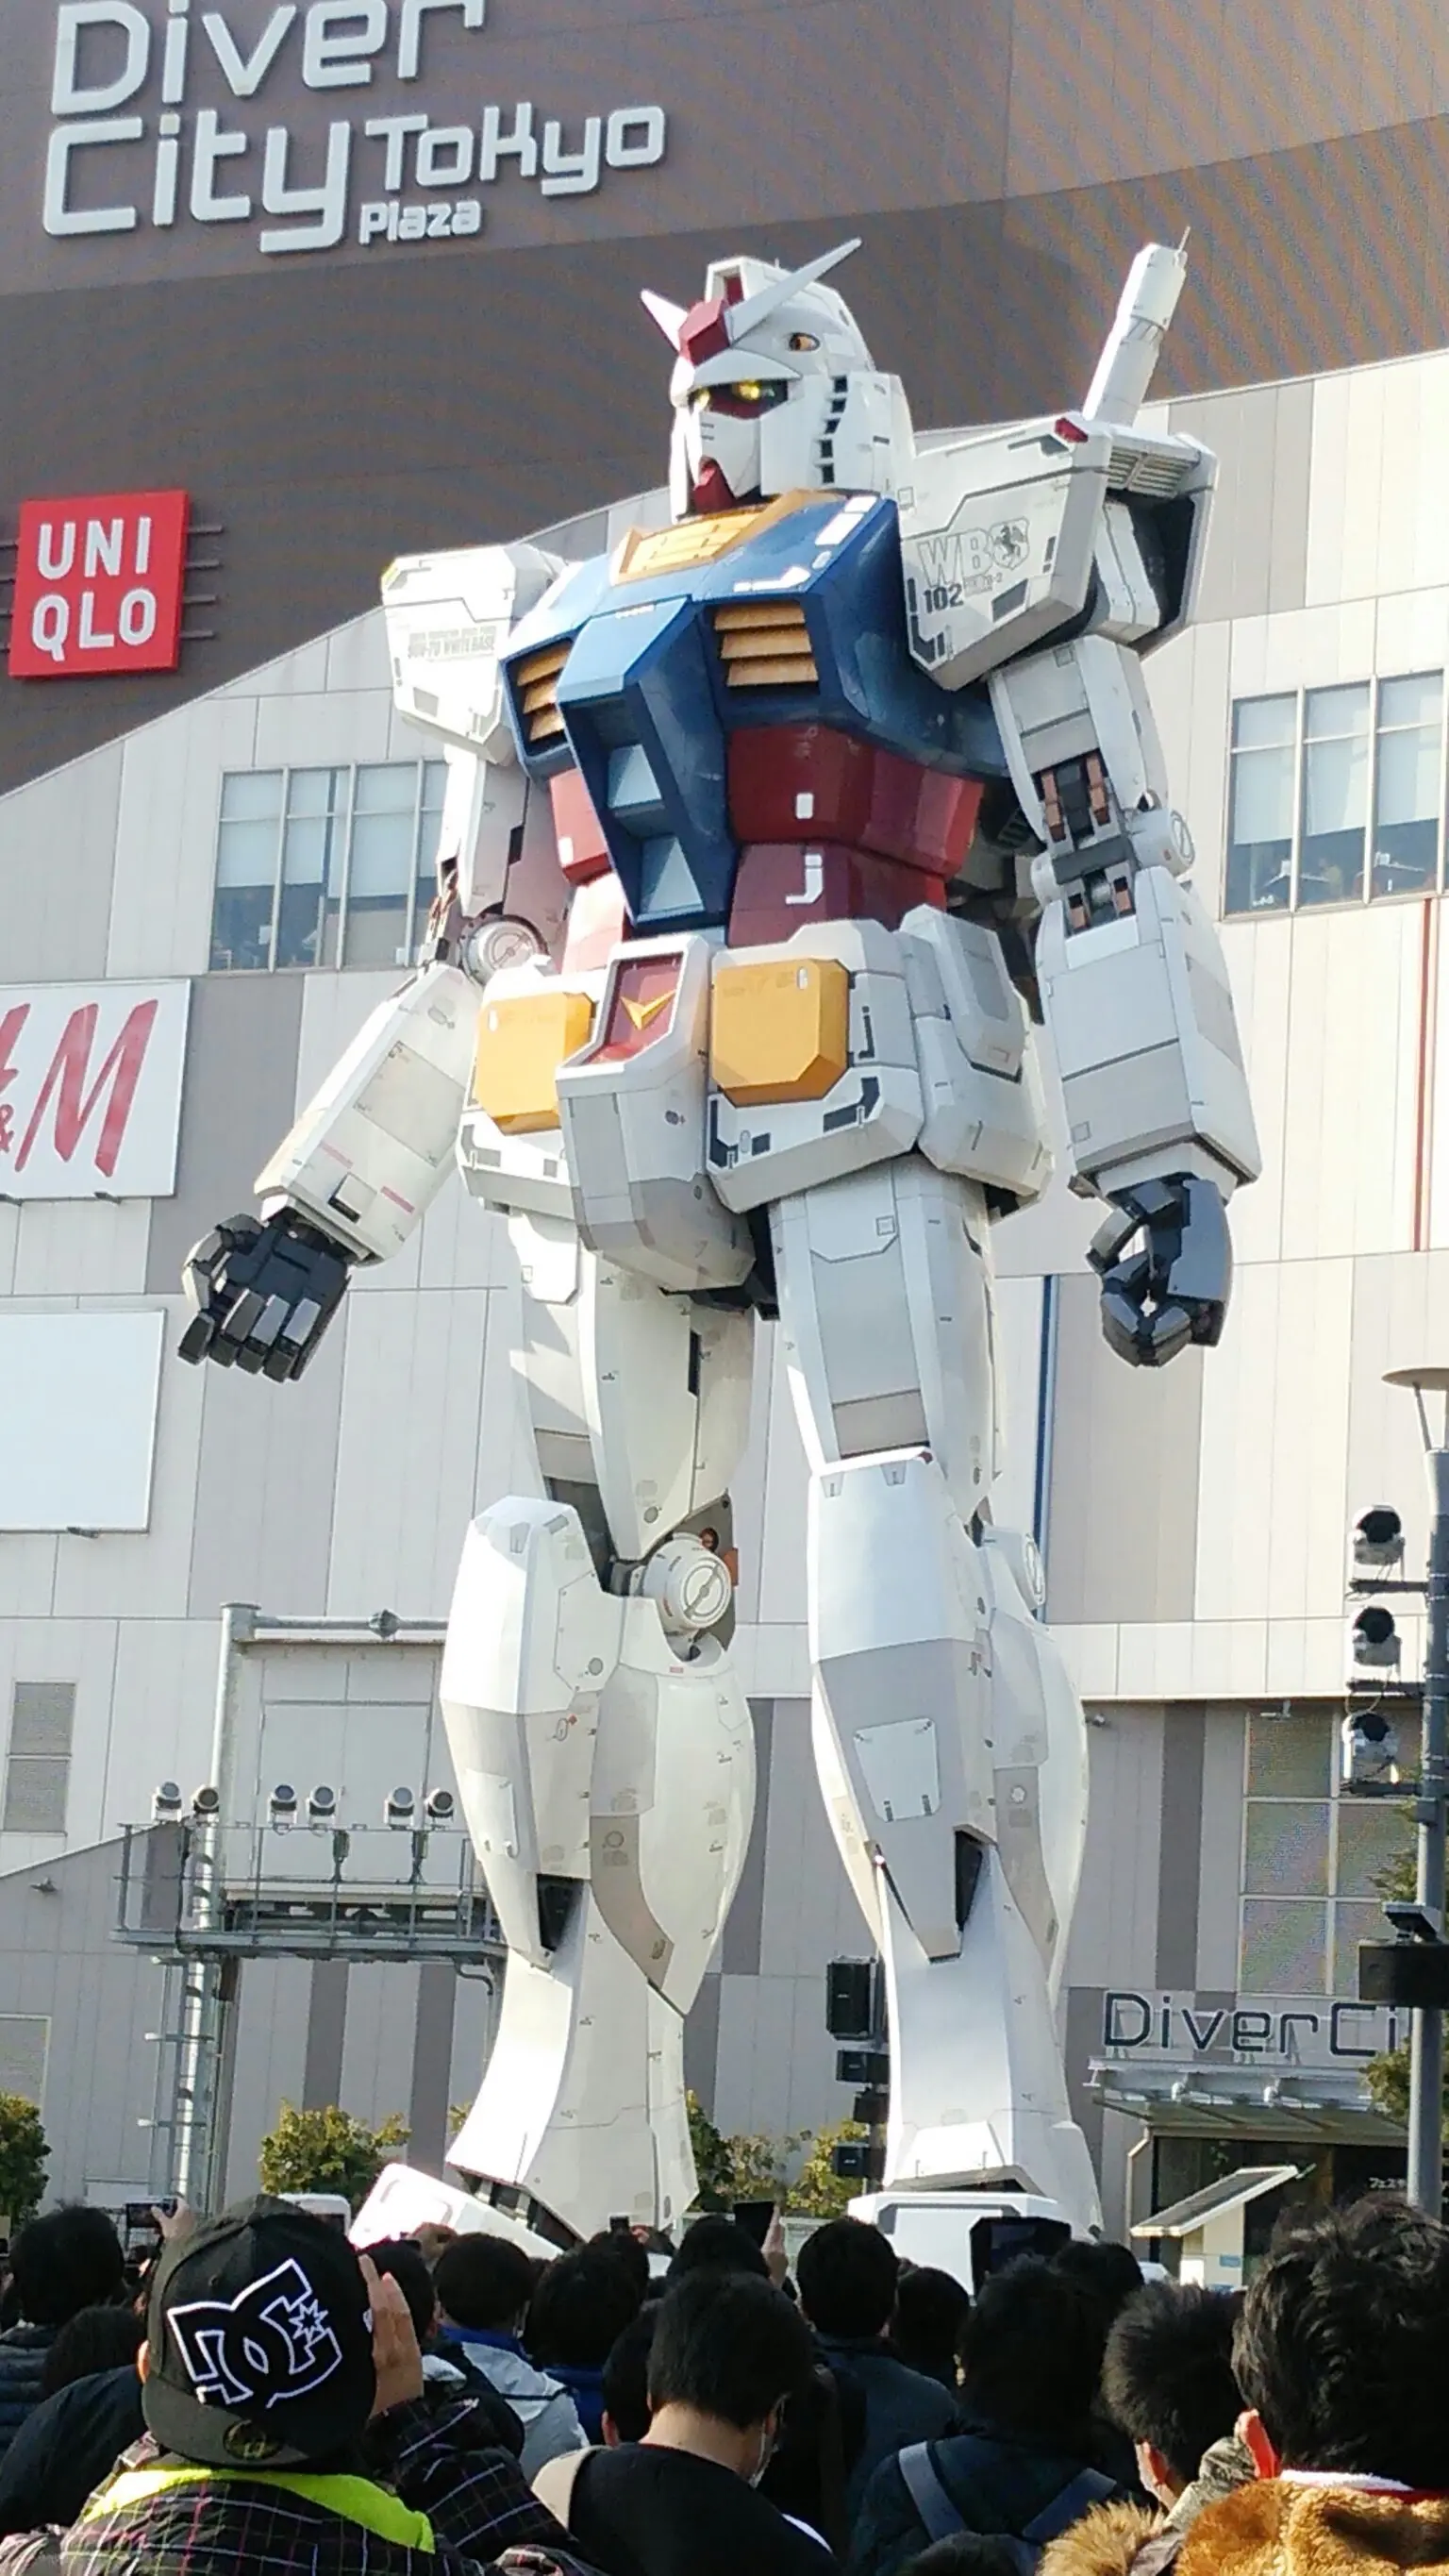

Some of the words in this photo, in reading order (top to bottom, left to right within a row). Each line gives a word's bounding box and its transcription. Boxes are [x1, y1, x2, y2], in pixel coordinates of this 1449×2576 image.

[51, 0, 484, 114] Diver
[42, 108, 350, 253] City
[365, 102, 664, 196] Tokyo
[359, 200, 481, 245] Plaza
[38, 516, 152, 580] UNI
[917, 528, 994, 587] WB
[31, 588, 158, 661] QLO
[924, 583, 964, 613] 102
[1103, 1992, 1415, 2057] DiverCi
